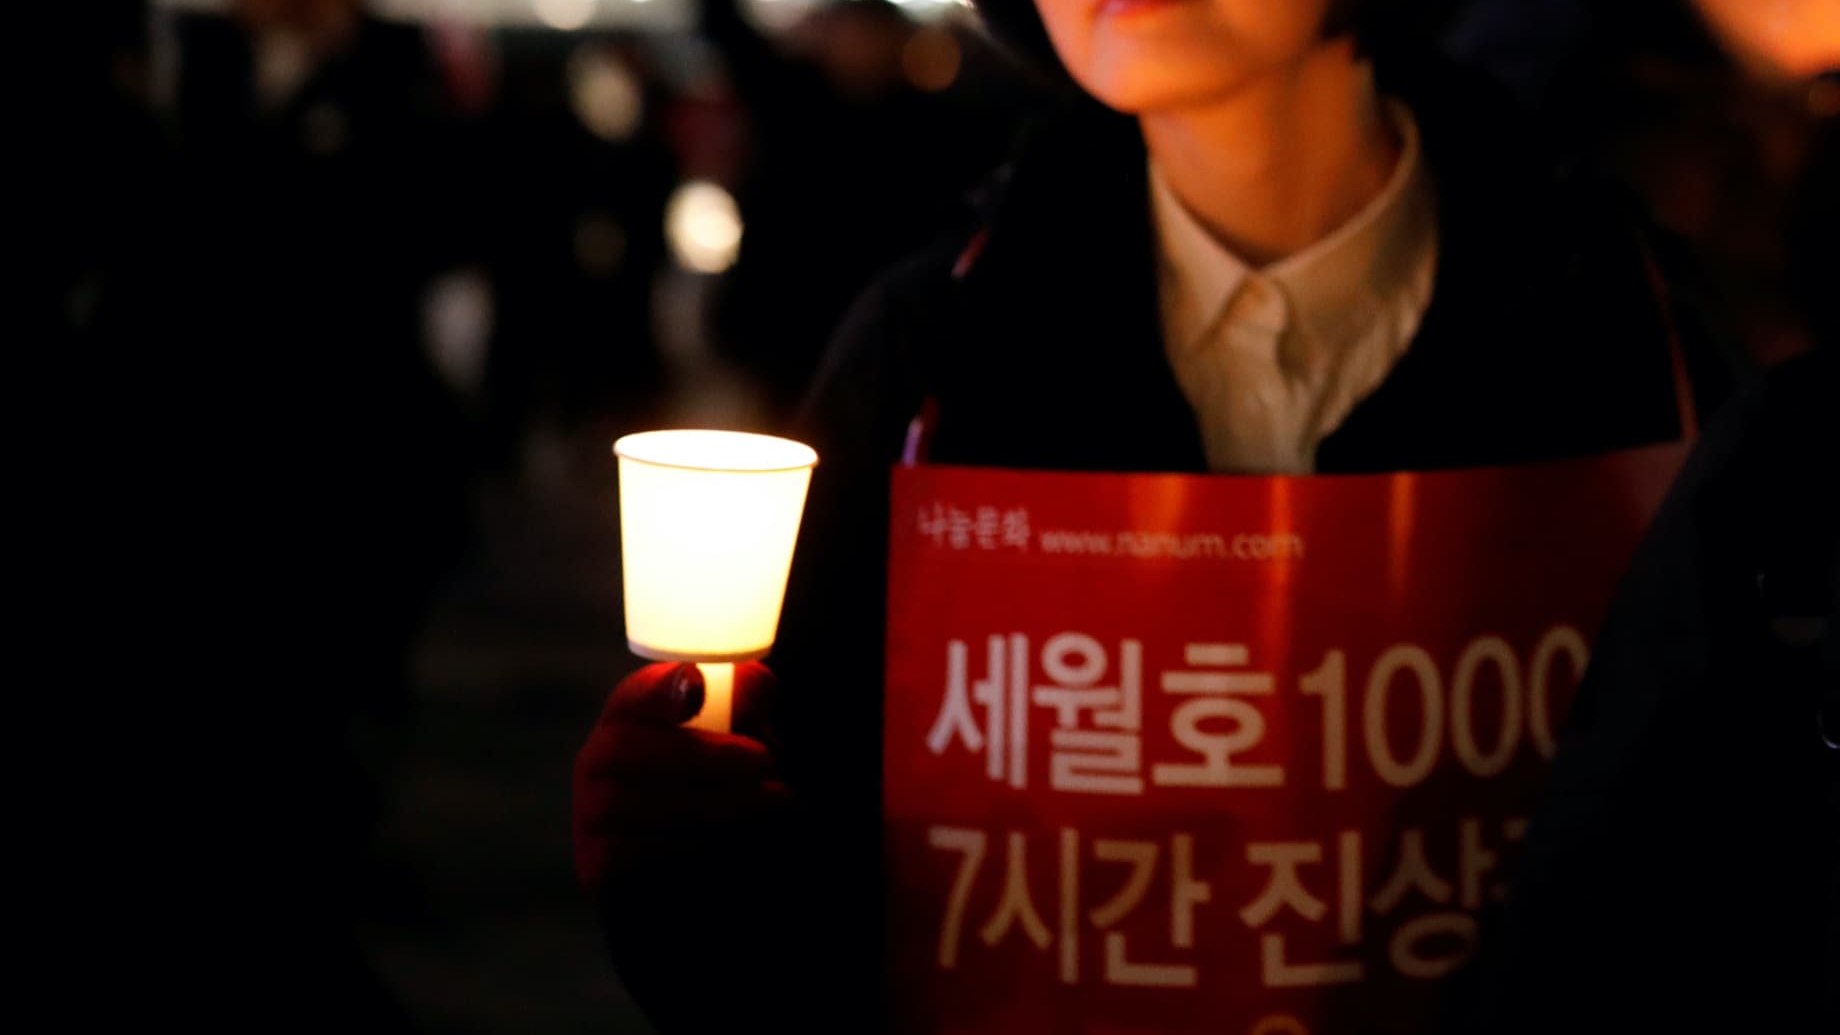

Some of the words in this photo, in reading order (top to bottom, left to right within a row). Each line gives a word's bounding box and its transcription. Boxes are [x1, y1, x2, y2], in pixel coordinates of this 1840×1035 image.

[917, 502, 1031, 552] 나눔문화
[1040, 529, 1304, 559] www.nanum.com
[924, 630, 1286, 796] 세월호
[926, 825, 1211, 987] 7시간
[1238, 816, 1532, 988] 진상
